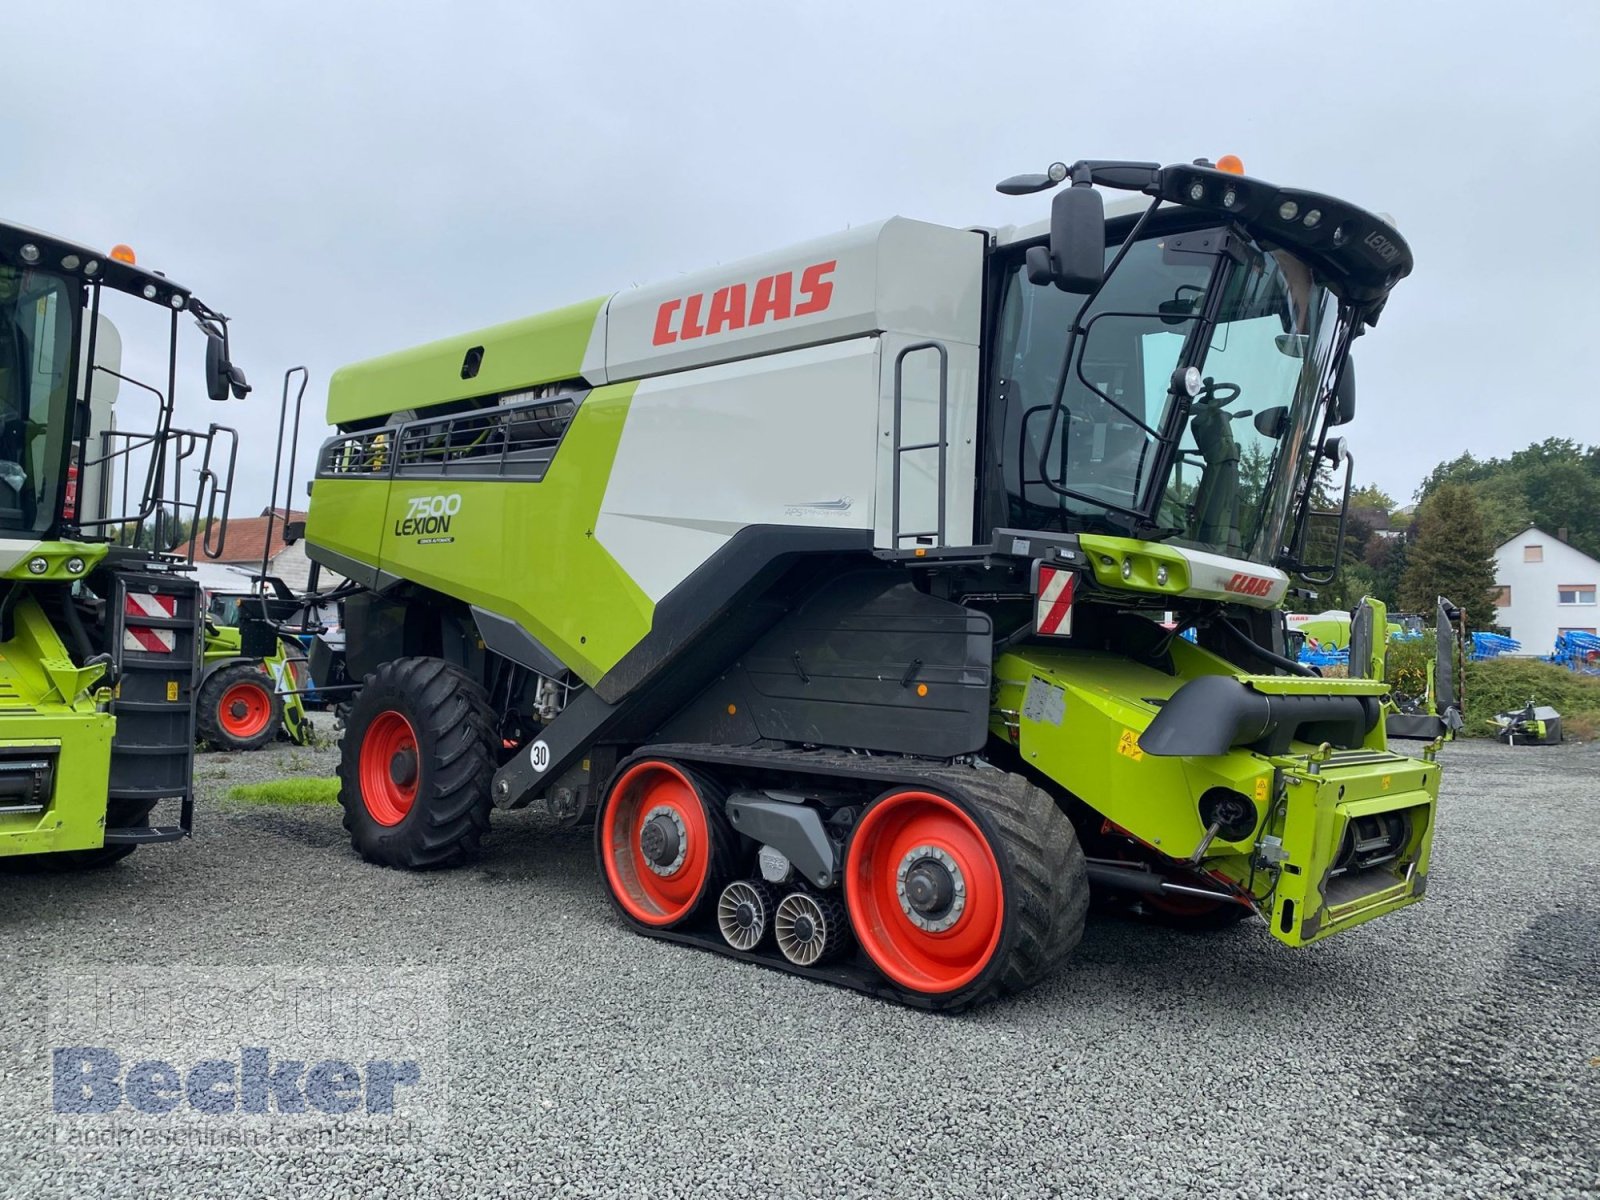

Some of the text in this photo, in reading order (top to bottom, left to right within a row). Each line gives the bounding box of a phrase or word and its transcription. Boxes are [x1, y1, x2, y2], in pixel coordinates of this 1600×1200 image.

[1364, 230, 1400, 263] LEXION
[652, 259, 837, 346] CLAAS
[406, 493, 462, 519] 7500
[395, 515, 451, 536] LEXION
[1224, 573, 1275, 597] CLAAS
[533, 746, 547, 766] 30
